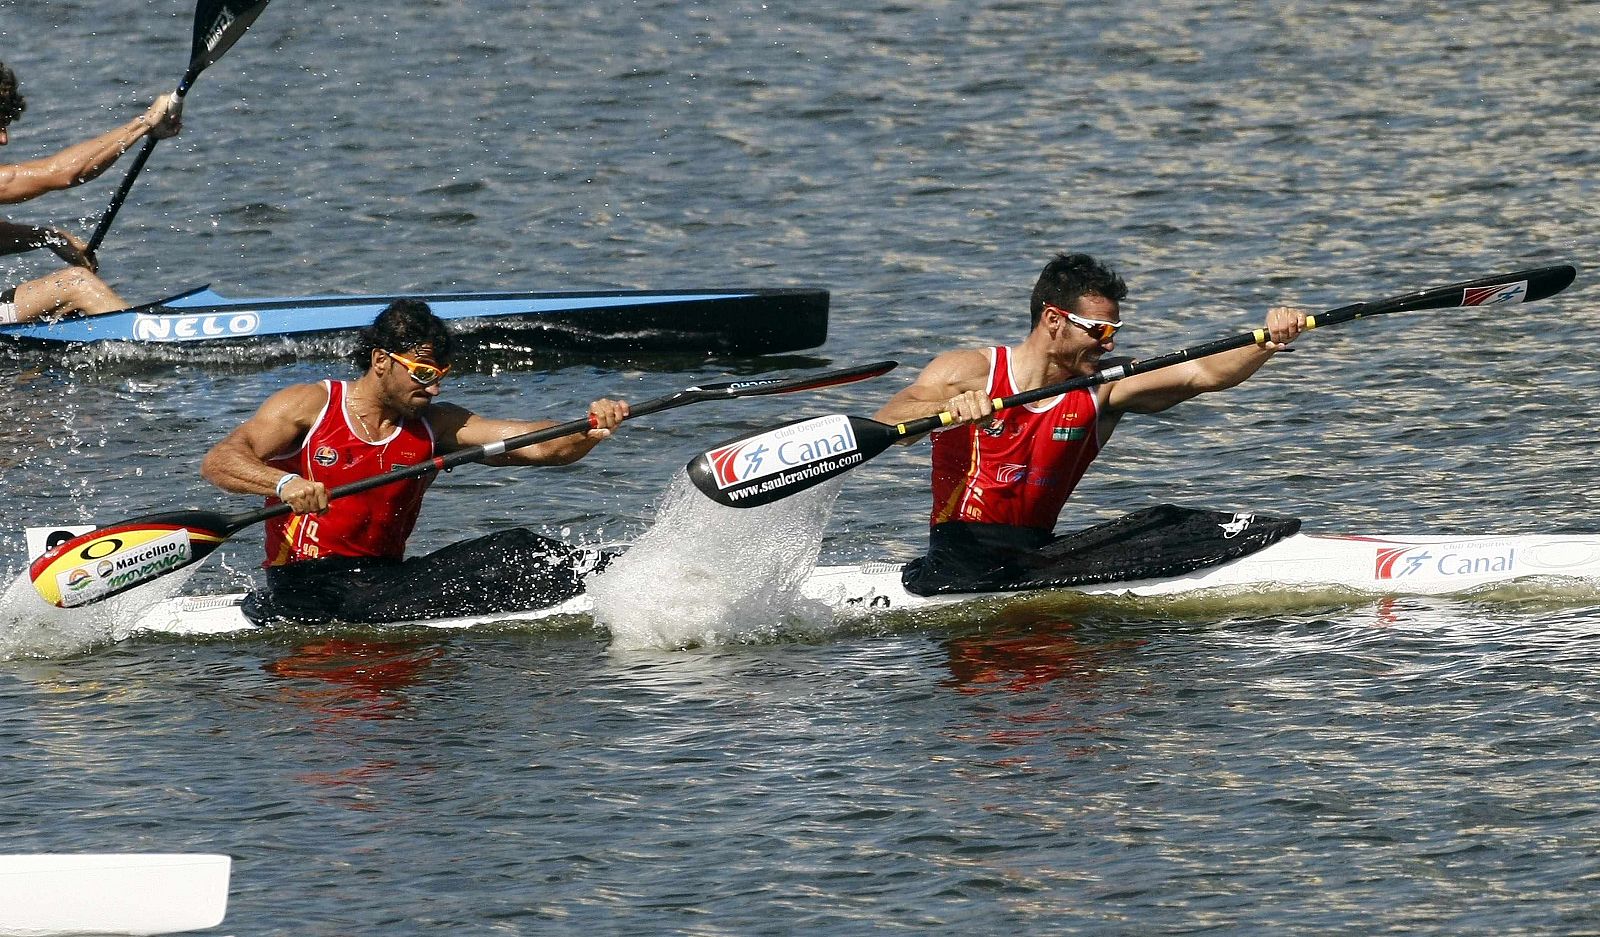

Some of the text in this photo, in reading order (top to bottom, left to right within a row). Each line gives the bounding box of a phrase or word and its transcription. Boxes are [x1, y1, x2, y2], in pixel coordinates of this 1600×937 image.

[138, 315, 257, 340] NELO
[774, 416, 842, 440] Club Deportivo
[777, 423, 854, 466] Canal
[727, 453, 863, 501] www.saulcraviotto.com
[116, 542, 176, 571] Marcelino
[1437, 548, 1514, 576] Canal
